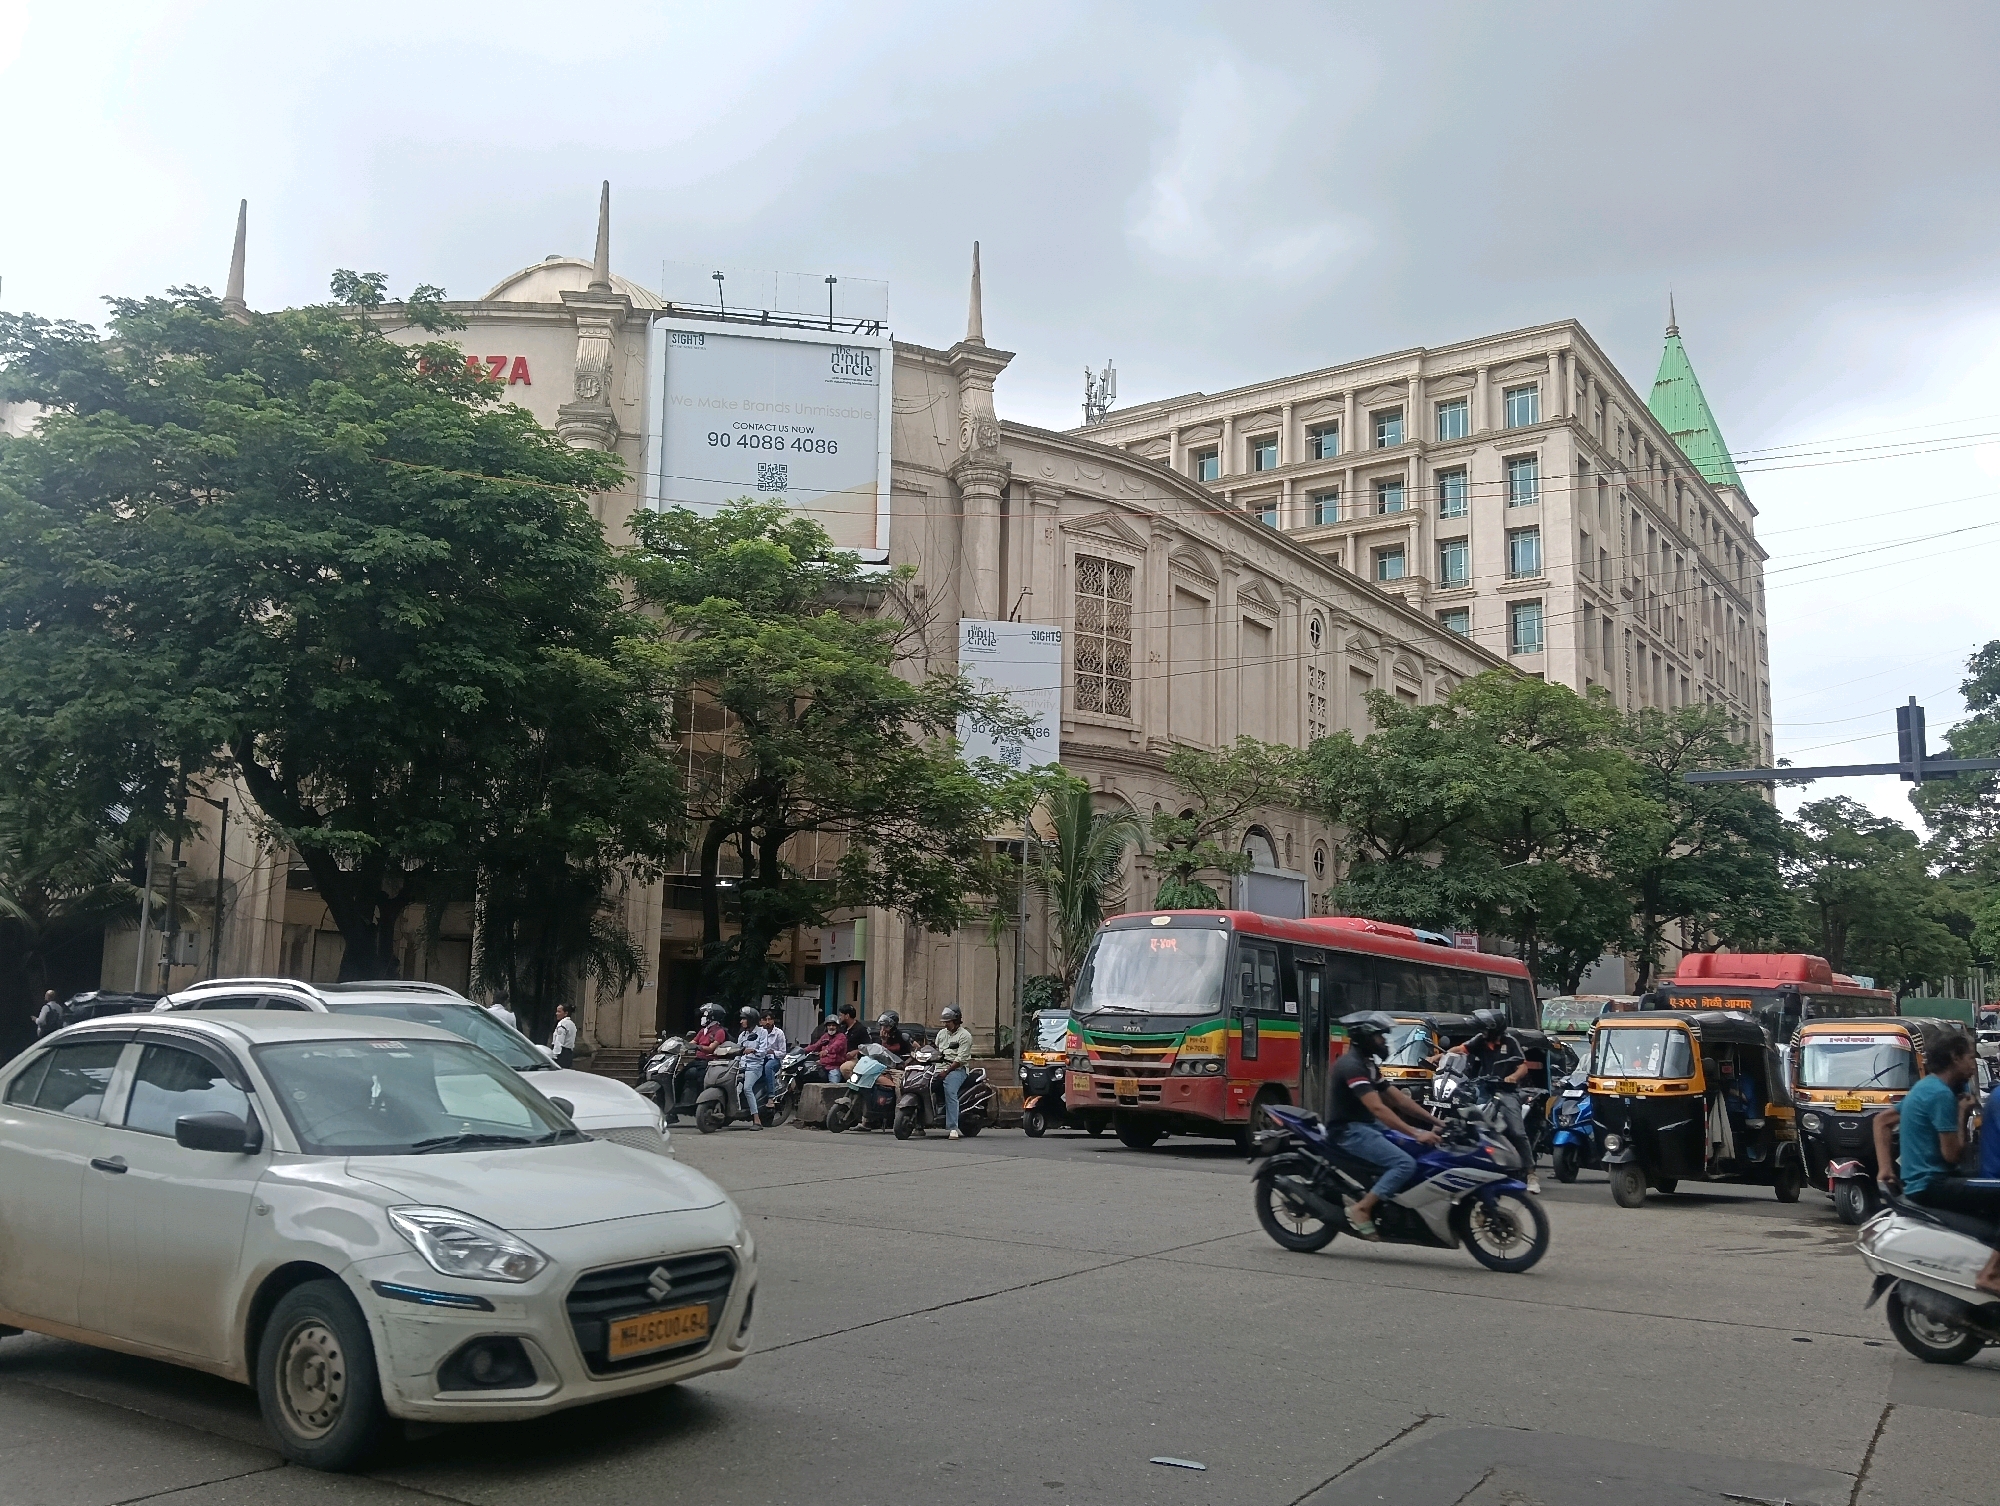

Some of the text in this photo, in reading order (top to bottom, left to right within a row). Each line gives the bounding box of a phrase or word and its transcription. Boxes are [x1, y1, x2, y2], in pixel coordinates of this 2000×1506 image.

[671, 333, 705, 346] SIGHT9
[835, 345, 851, 355] the
[831, 350, 870, 366] ninth
[419, 355, 532, 386] PAZA
[831, 363, 873, 377] circle
[670, 394, 876, 421] We Make Brands Unmissable.
[732, 421, 815, 434] CONTACT US NOW
[707, 431, 838, 455] 90 4086 4086
[967, 627, 995, 639] ninth
[1031, 630, 1062, 643] SIGHT9
[968, 637, 997, 647] circle
[971, 723, 986, 734] 90
[1122, 1025, 1142, 1033] TATA
